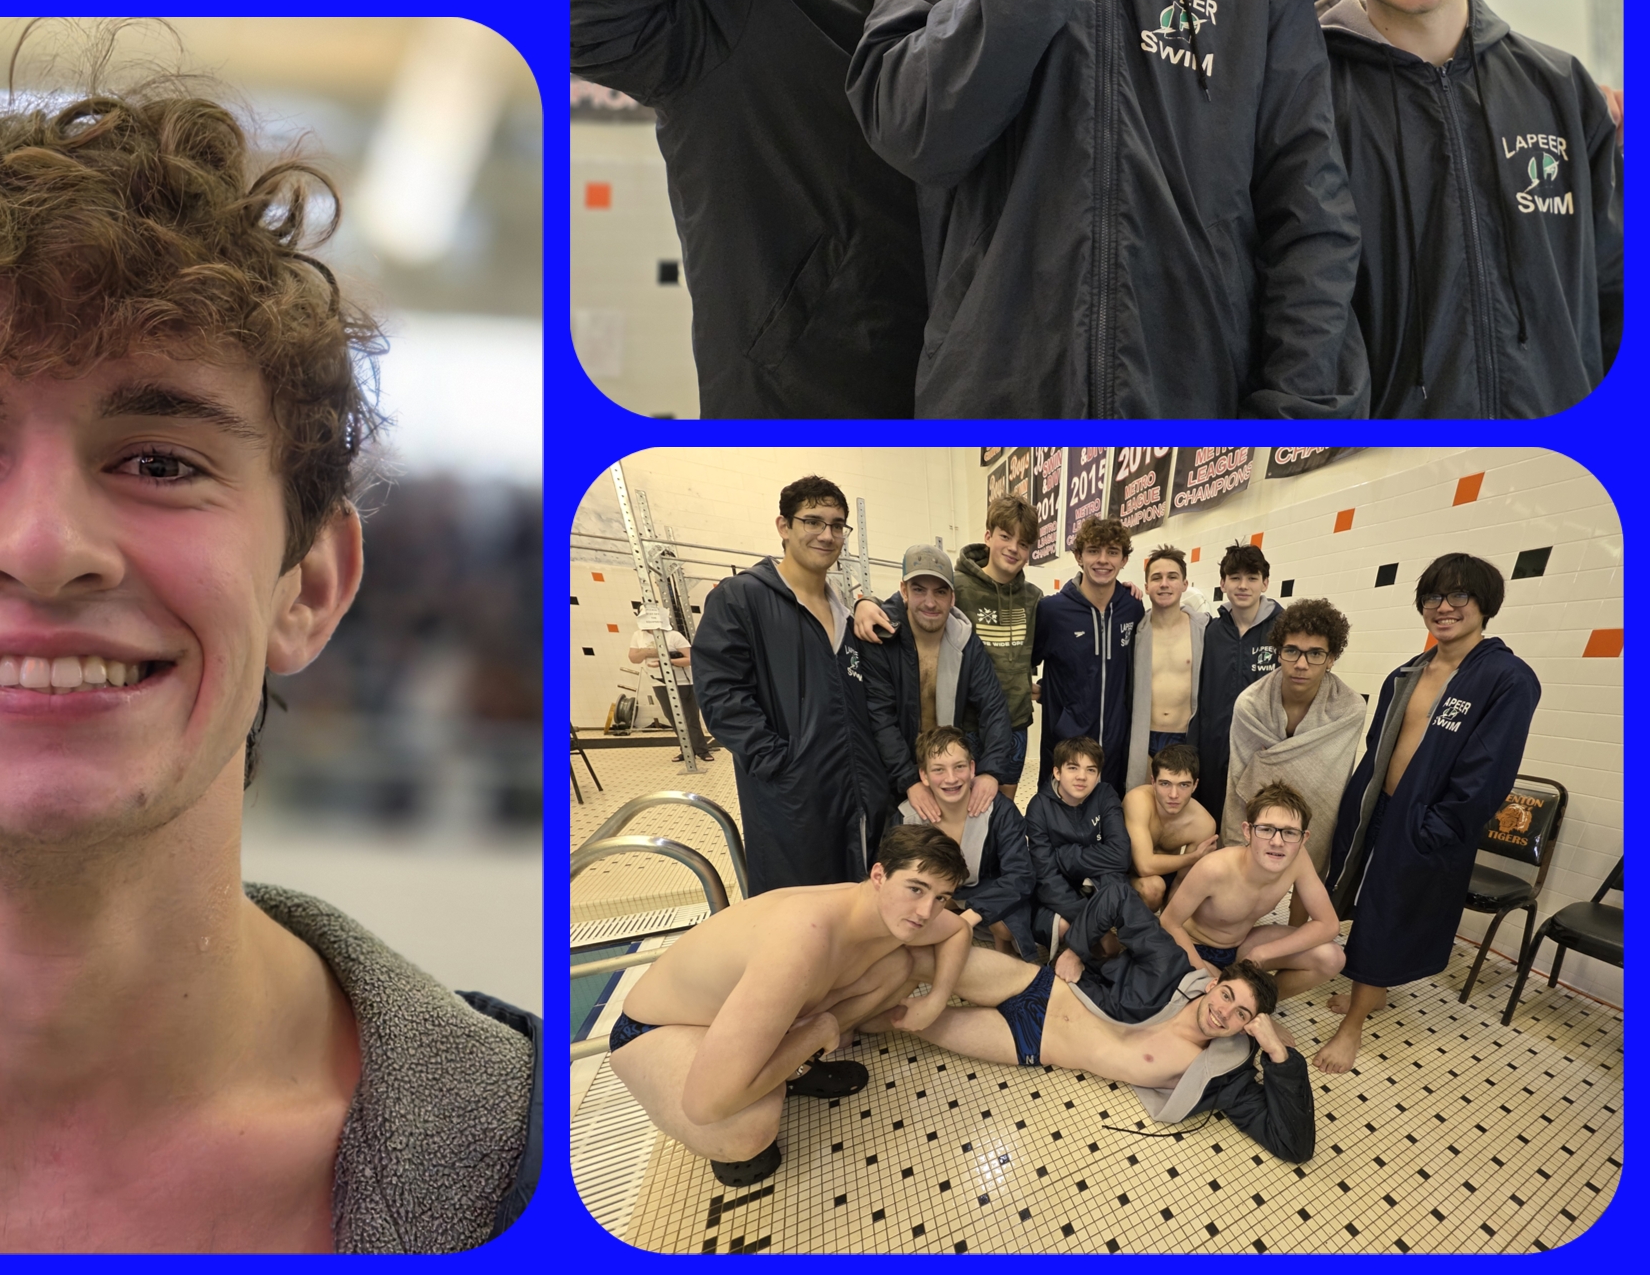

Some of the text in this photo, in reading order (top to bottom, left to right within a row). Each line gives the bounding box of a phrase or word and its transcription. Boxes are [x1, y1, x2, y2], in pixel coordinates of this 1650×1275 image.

[1140, 30, 1214, 77] SWIM
[1501, 133, 1569, 162] LAPEER
[1516, 191, 1574, 215] SWIM
[1187, 447, 1250, 488] LEAGUE
[1070, 458, 1107, 507] 2015
[1124, 470, 1157, 501] METRO
[1174, 460, 1254, 508] CHAMPIONS
[1075, 497, 1101, 520] METRO
[1119, 486, 1161, 518] LEAGUE
[1120, 500, 1167, 529] HAMPIONS
[1251, 663, 1276, 672] SWIM
[1442, 696, 1472, 715] APEER
[1505, 793, 1545, 808] ENTON
[1488, 829, 1529, 846] TIGERS
